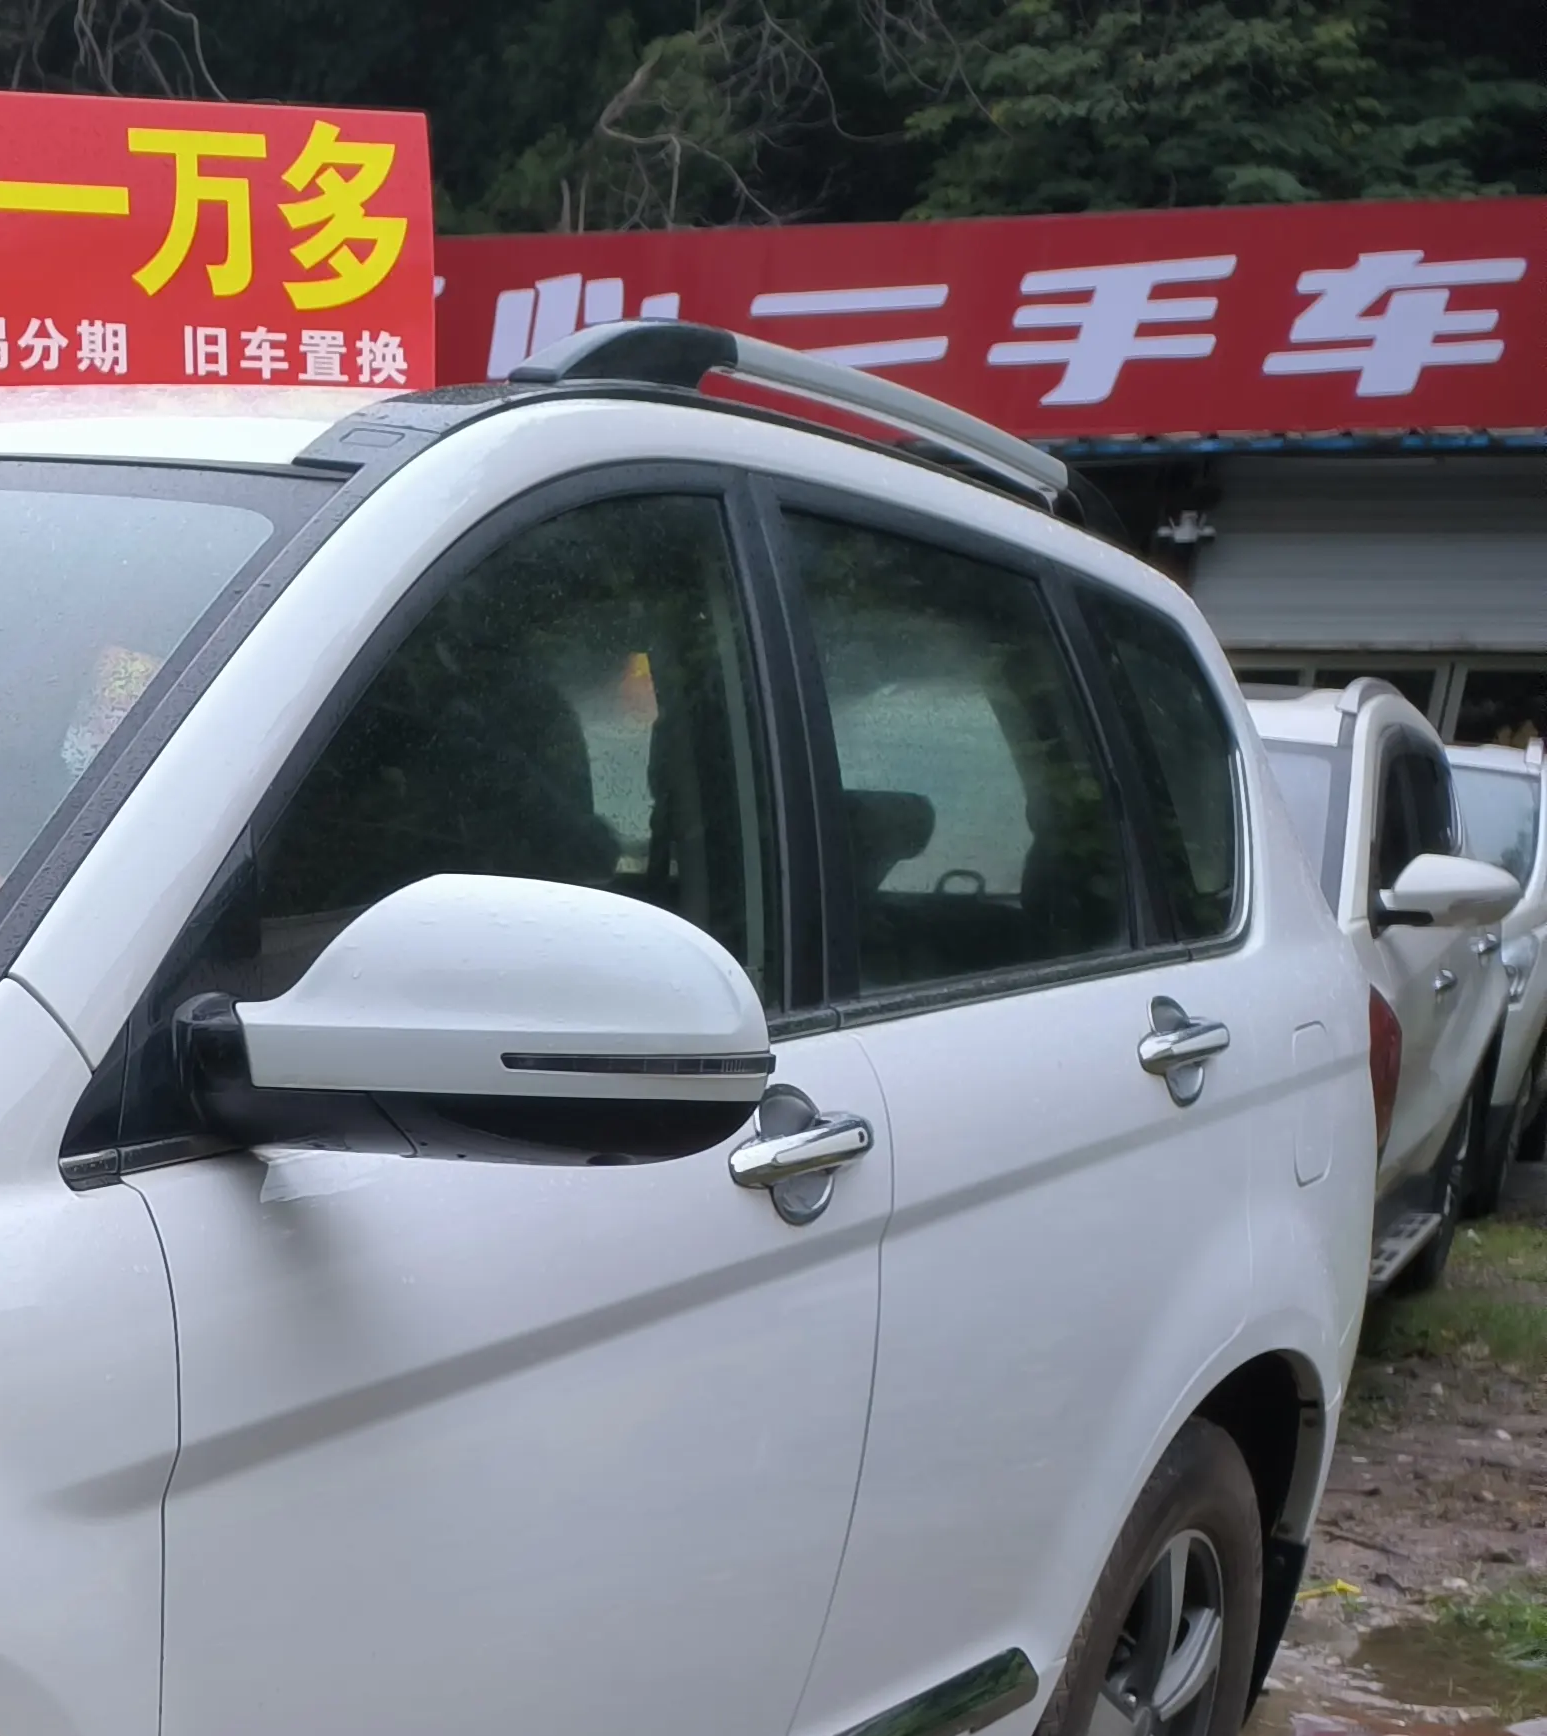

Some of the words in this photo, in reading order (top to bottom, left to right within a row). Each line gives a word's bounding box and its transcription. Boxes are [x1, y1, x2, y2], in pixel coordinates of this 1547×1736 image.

[183, 325, 409, 386] 旧车置换
[435, 249, 1527, 407] 心二手车
